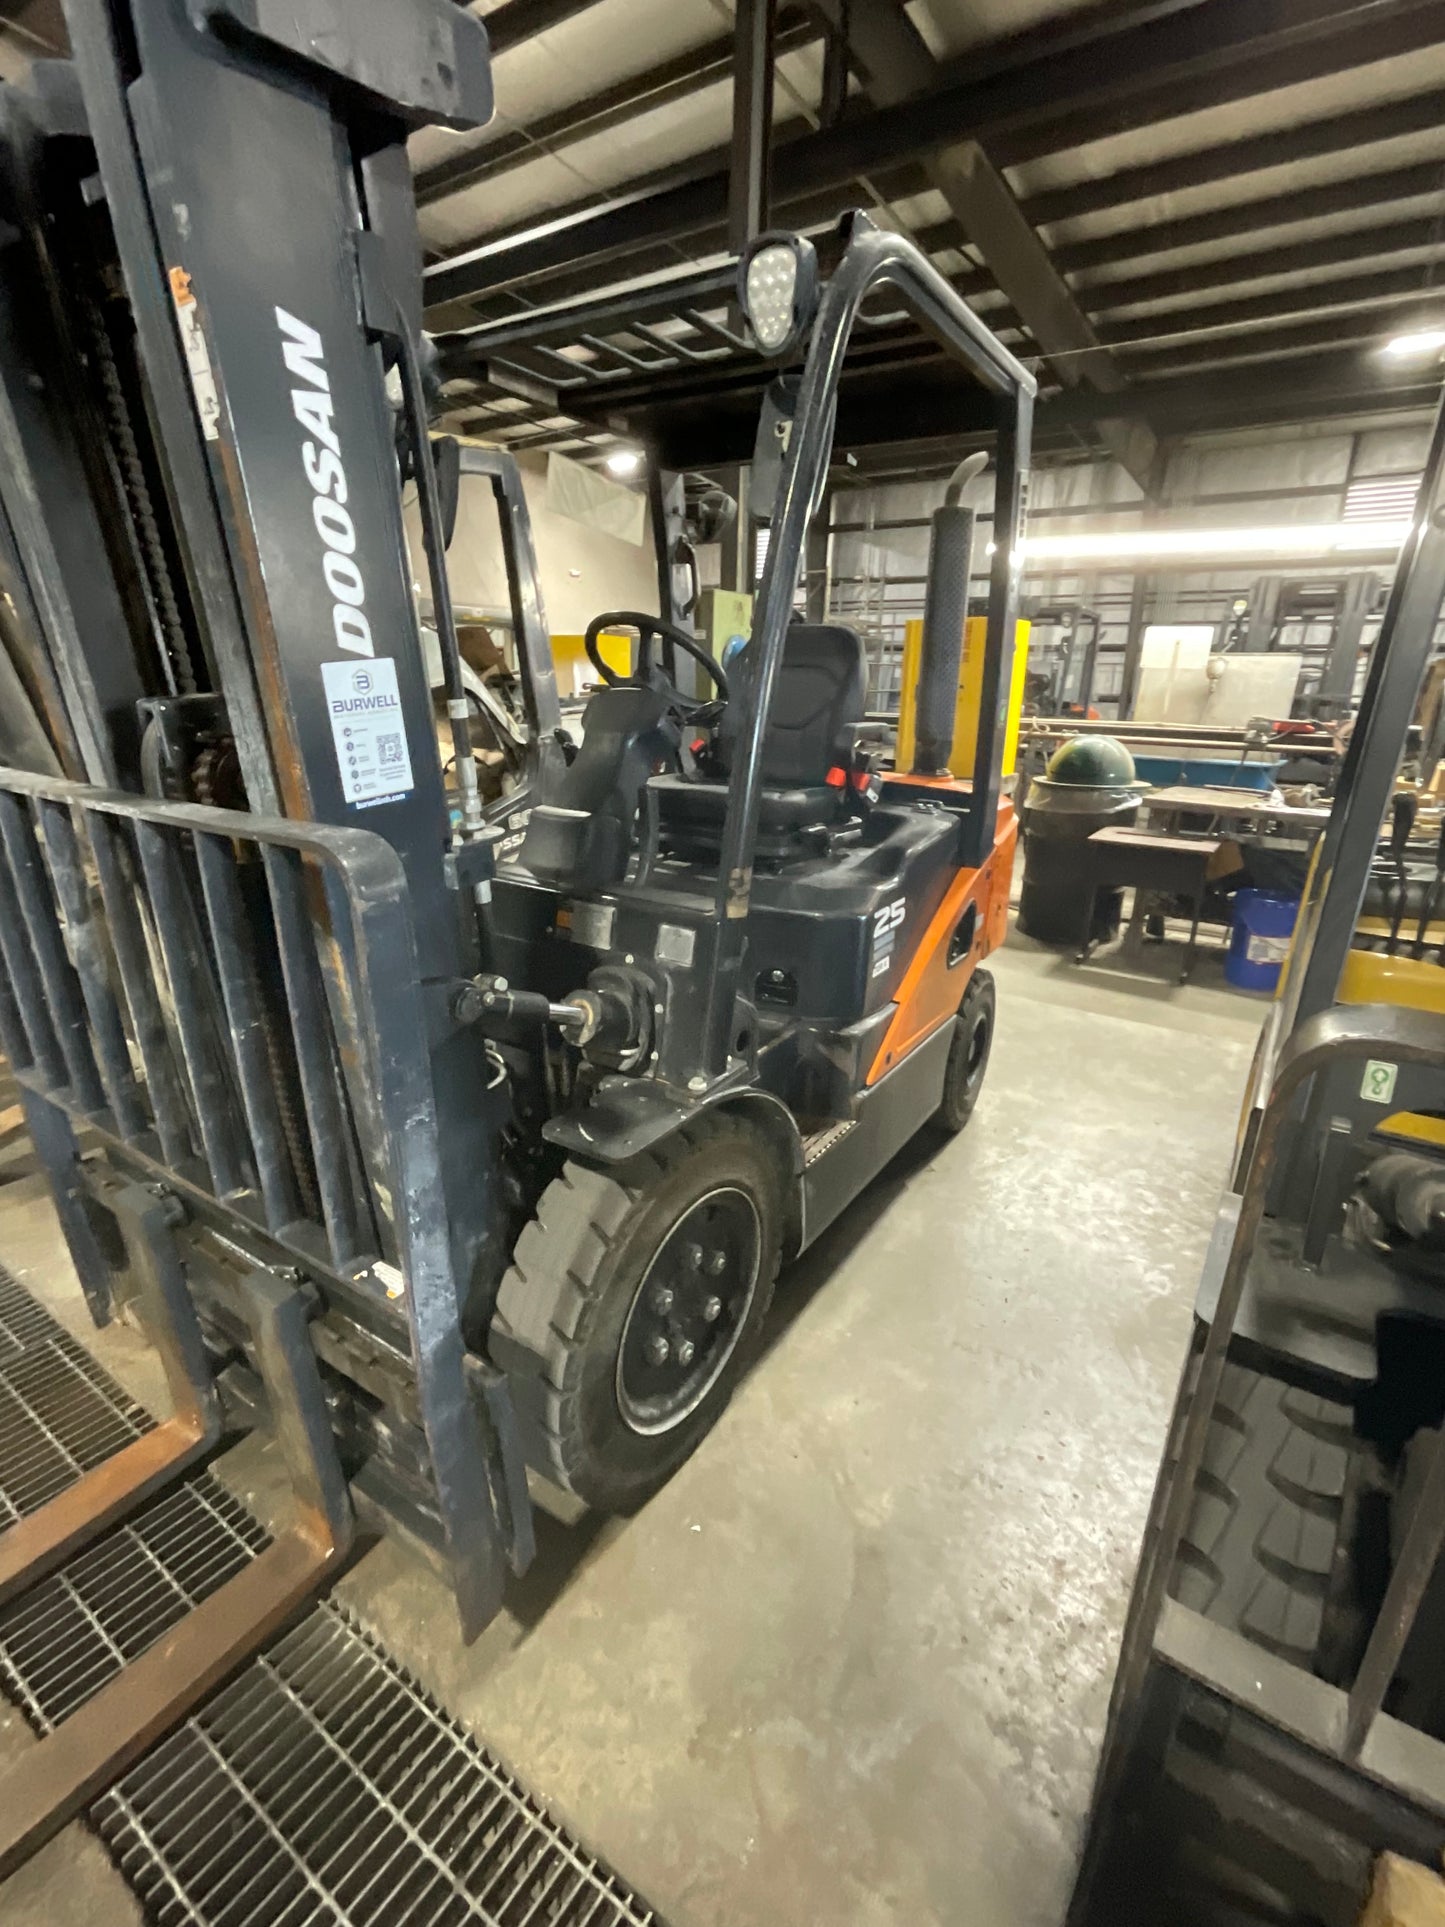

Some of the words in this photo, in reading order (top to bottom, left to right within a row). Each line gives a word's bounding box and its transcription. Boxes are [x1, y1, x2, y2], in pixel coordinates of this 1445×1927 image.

[274, 306, 375, 657] DOOSAN
[331, 694, 398, 713] BURWELL
[873, 896, 906, 939] 25
